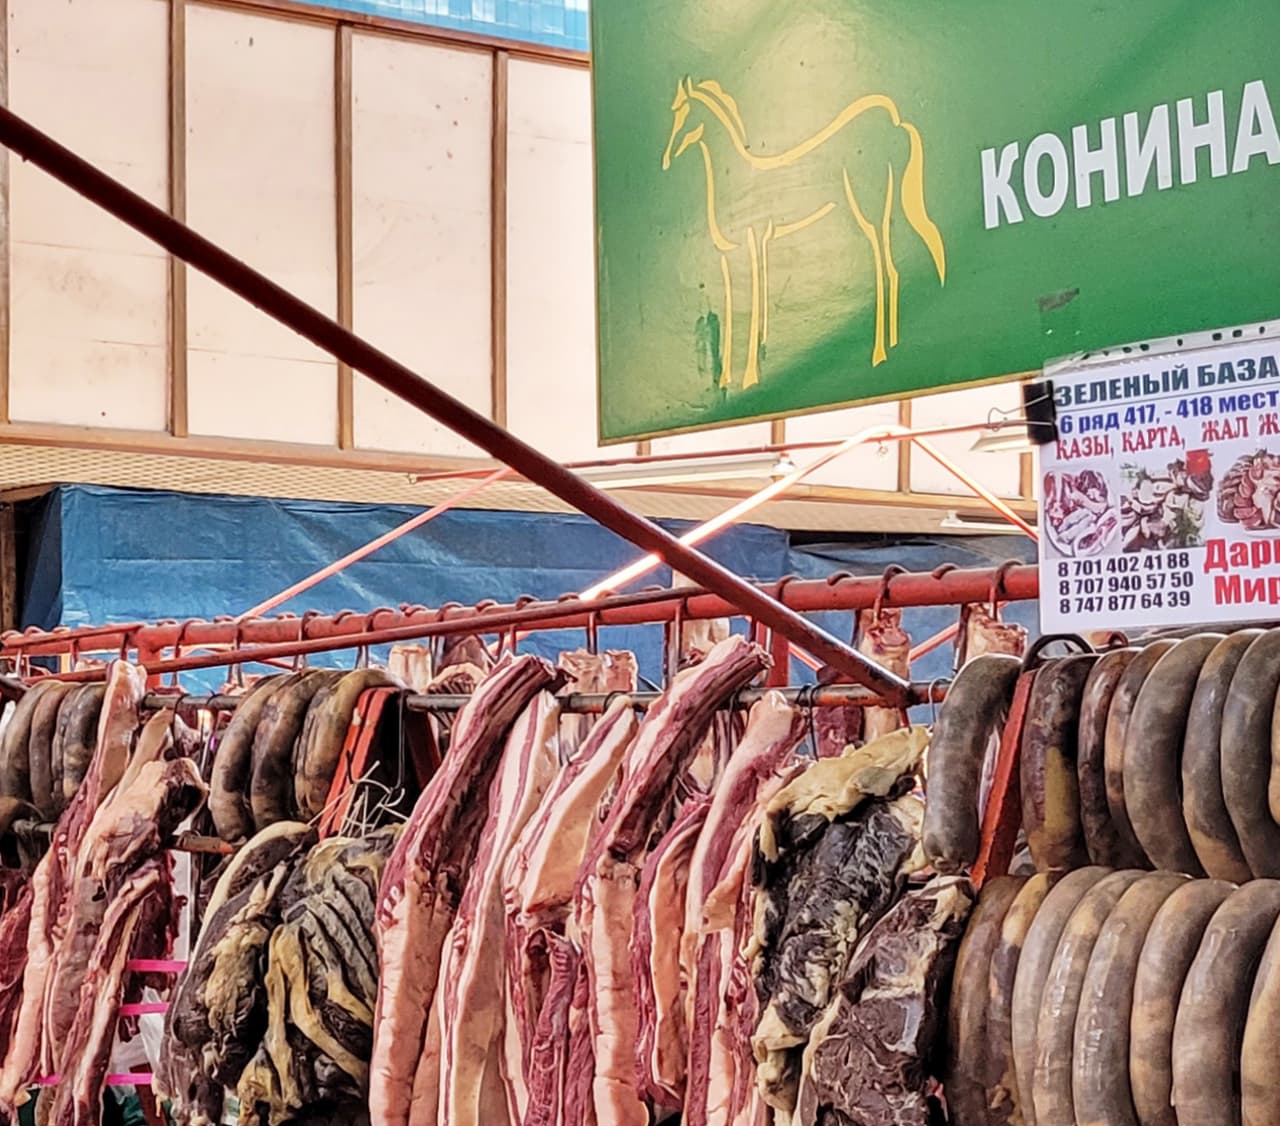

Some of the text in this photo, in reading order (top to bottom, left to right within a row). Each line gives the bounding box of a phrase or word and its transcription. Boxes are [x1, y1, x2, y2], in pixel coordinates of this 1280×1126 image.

[1055, 363, 1190, 408] ЗЕЛЕНЫЙ
[1060, 414, 1073, 435] 6
[1078, 410, 1121, 434] ряд
[1176, 395, 1213, 419] 418
[1201, 417, 1249, 444] ЖАЛ
[1058, 551, 1190, 578] 8 701 402 41 88
[1059, 571, 1194, 596] 8 707 940 57 50
[1060, 590, 1191, 615] 8 747 877 64 39
